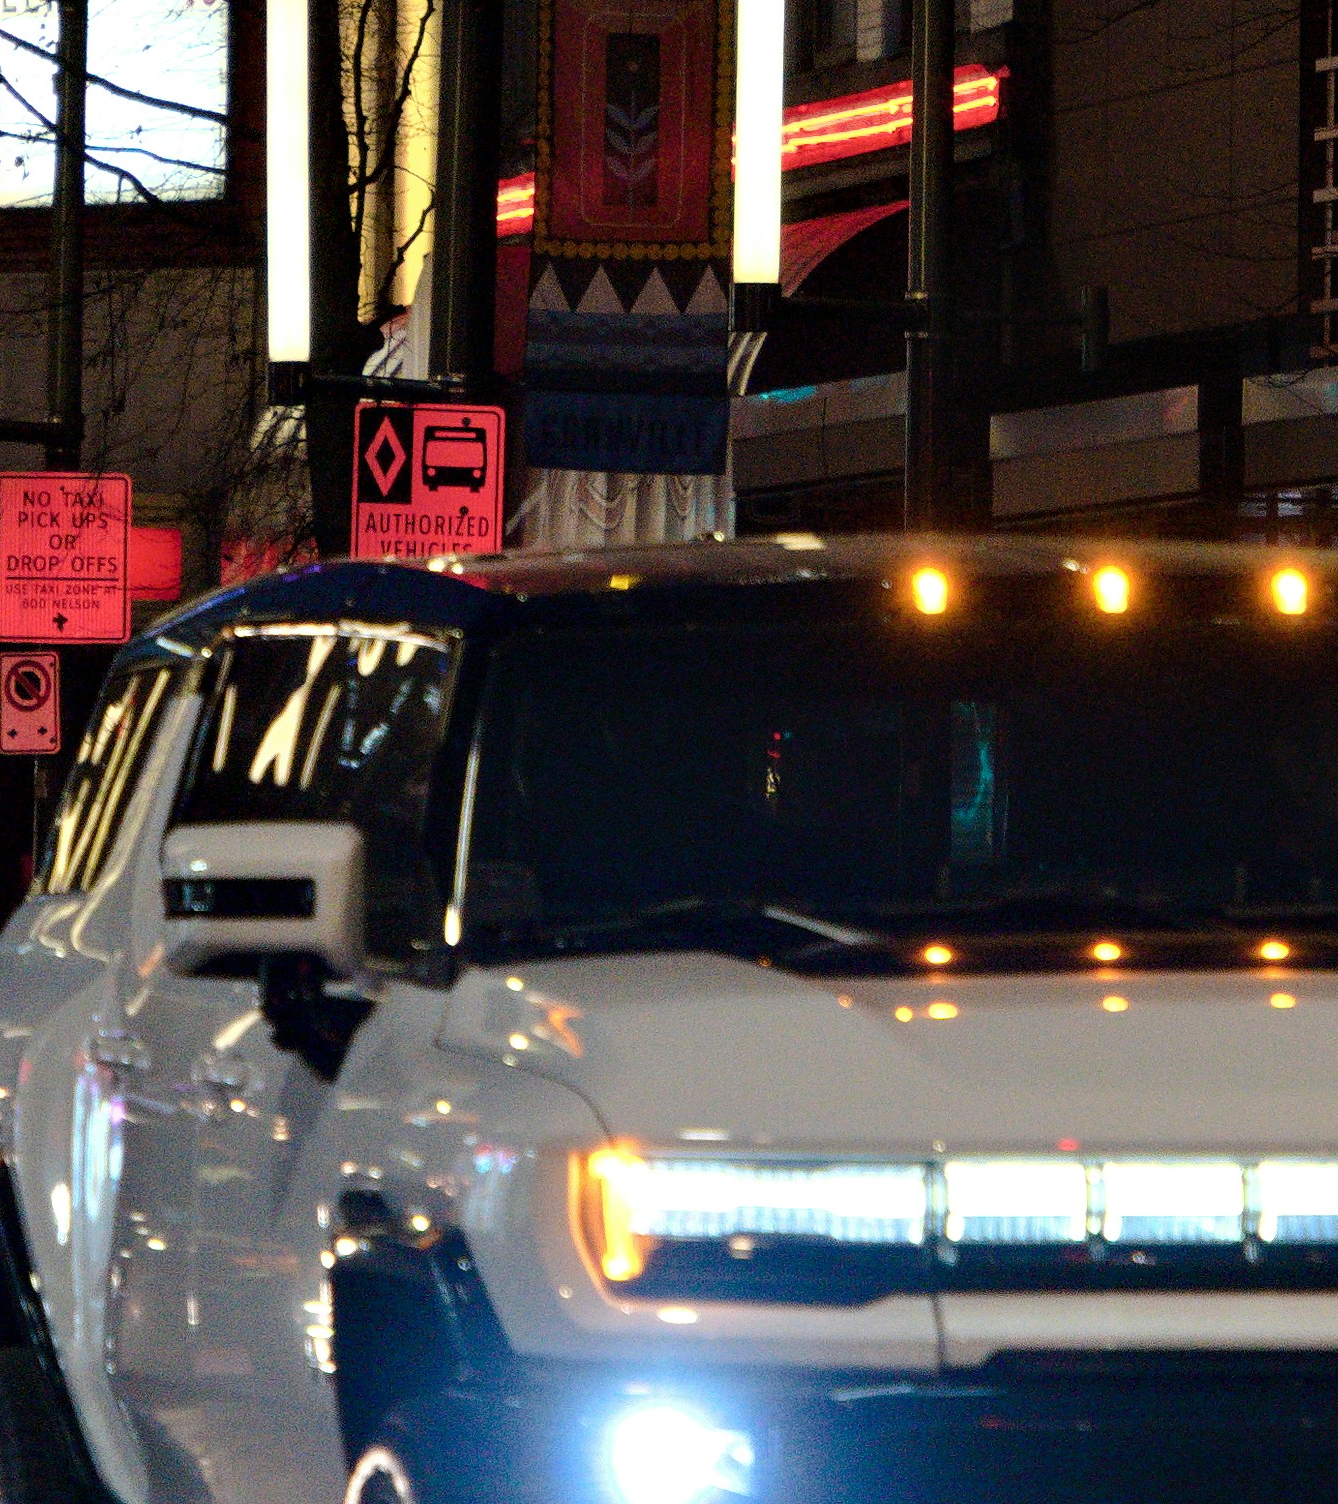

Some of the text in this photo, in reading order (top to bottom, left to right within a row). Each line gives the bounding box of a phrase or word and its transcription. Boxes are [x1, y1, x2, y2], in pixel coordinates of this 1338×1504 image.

[23, 491, 104, 507] NO TAXI
[18, 512, 108, 529] PICK UPS
[365, 511, 489, 537] AUTHORIZED
[49, 534, 77, 550] OR
[7, 555, 117, 573] DROP OFFS
[5, 584, 28, 595] USE
[35, 584, 59, 595] TAXI
[66, 584, 98, 595] ZONE
[52, 598, 101, 610] NELSON
